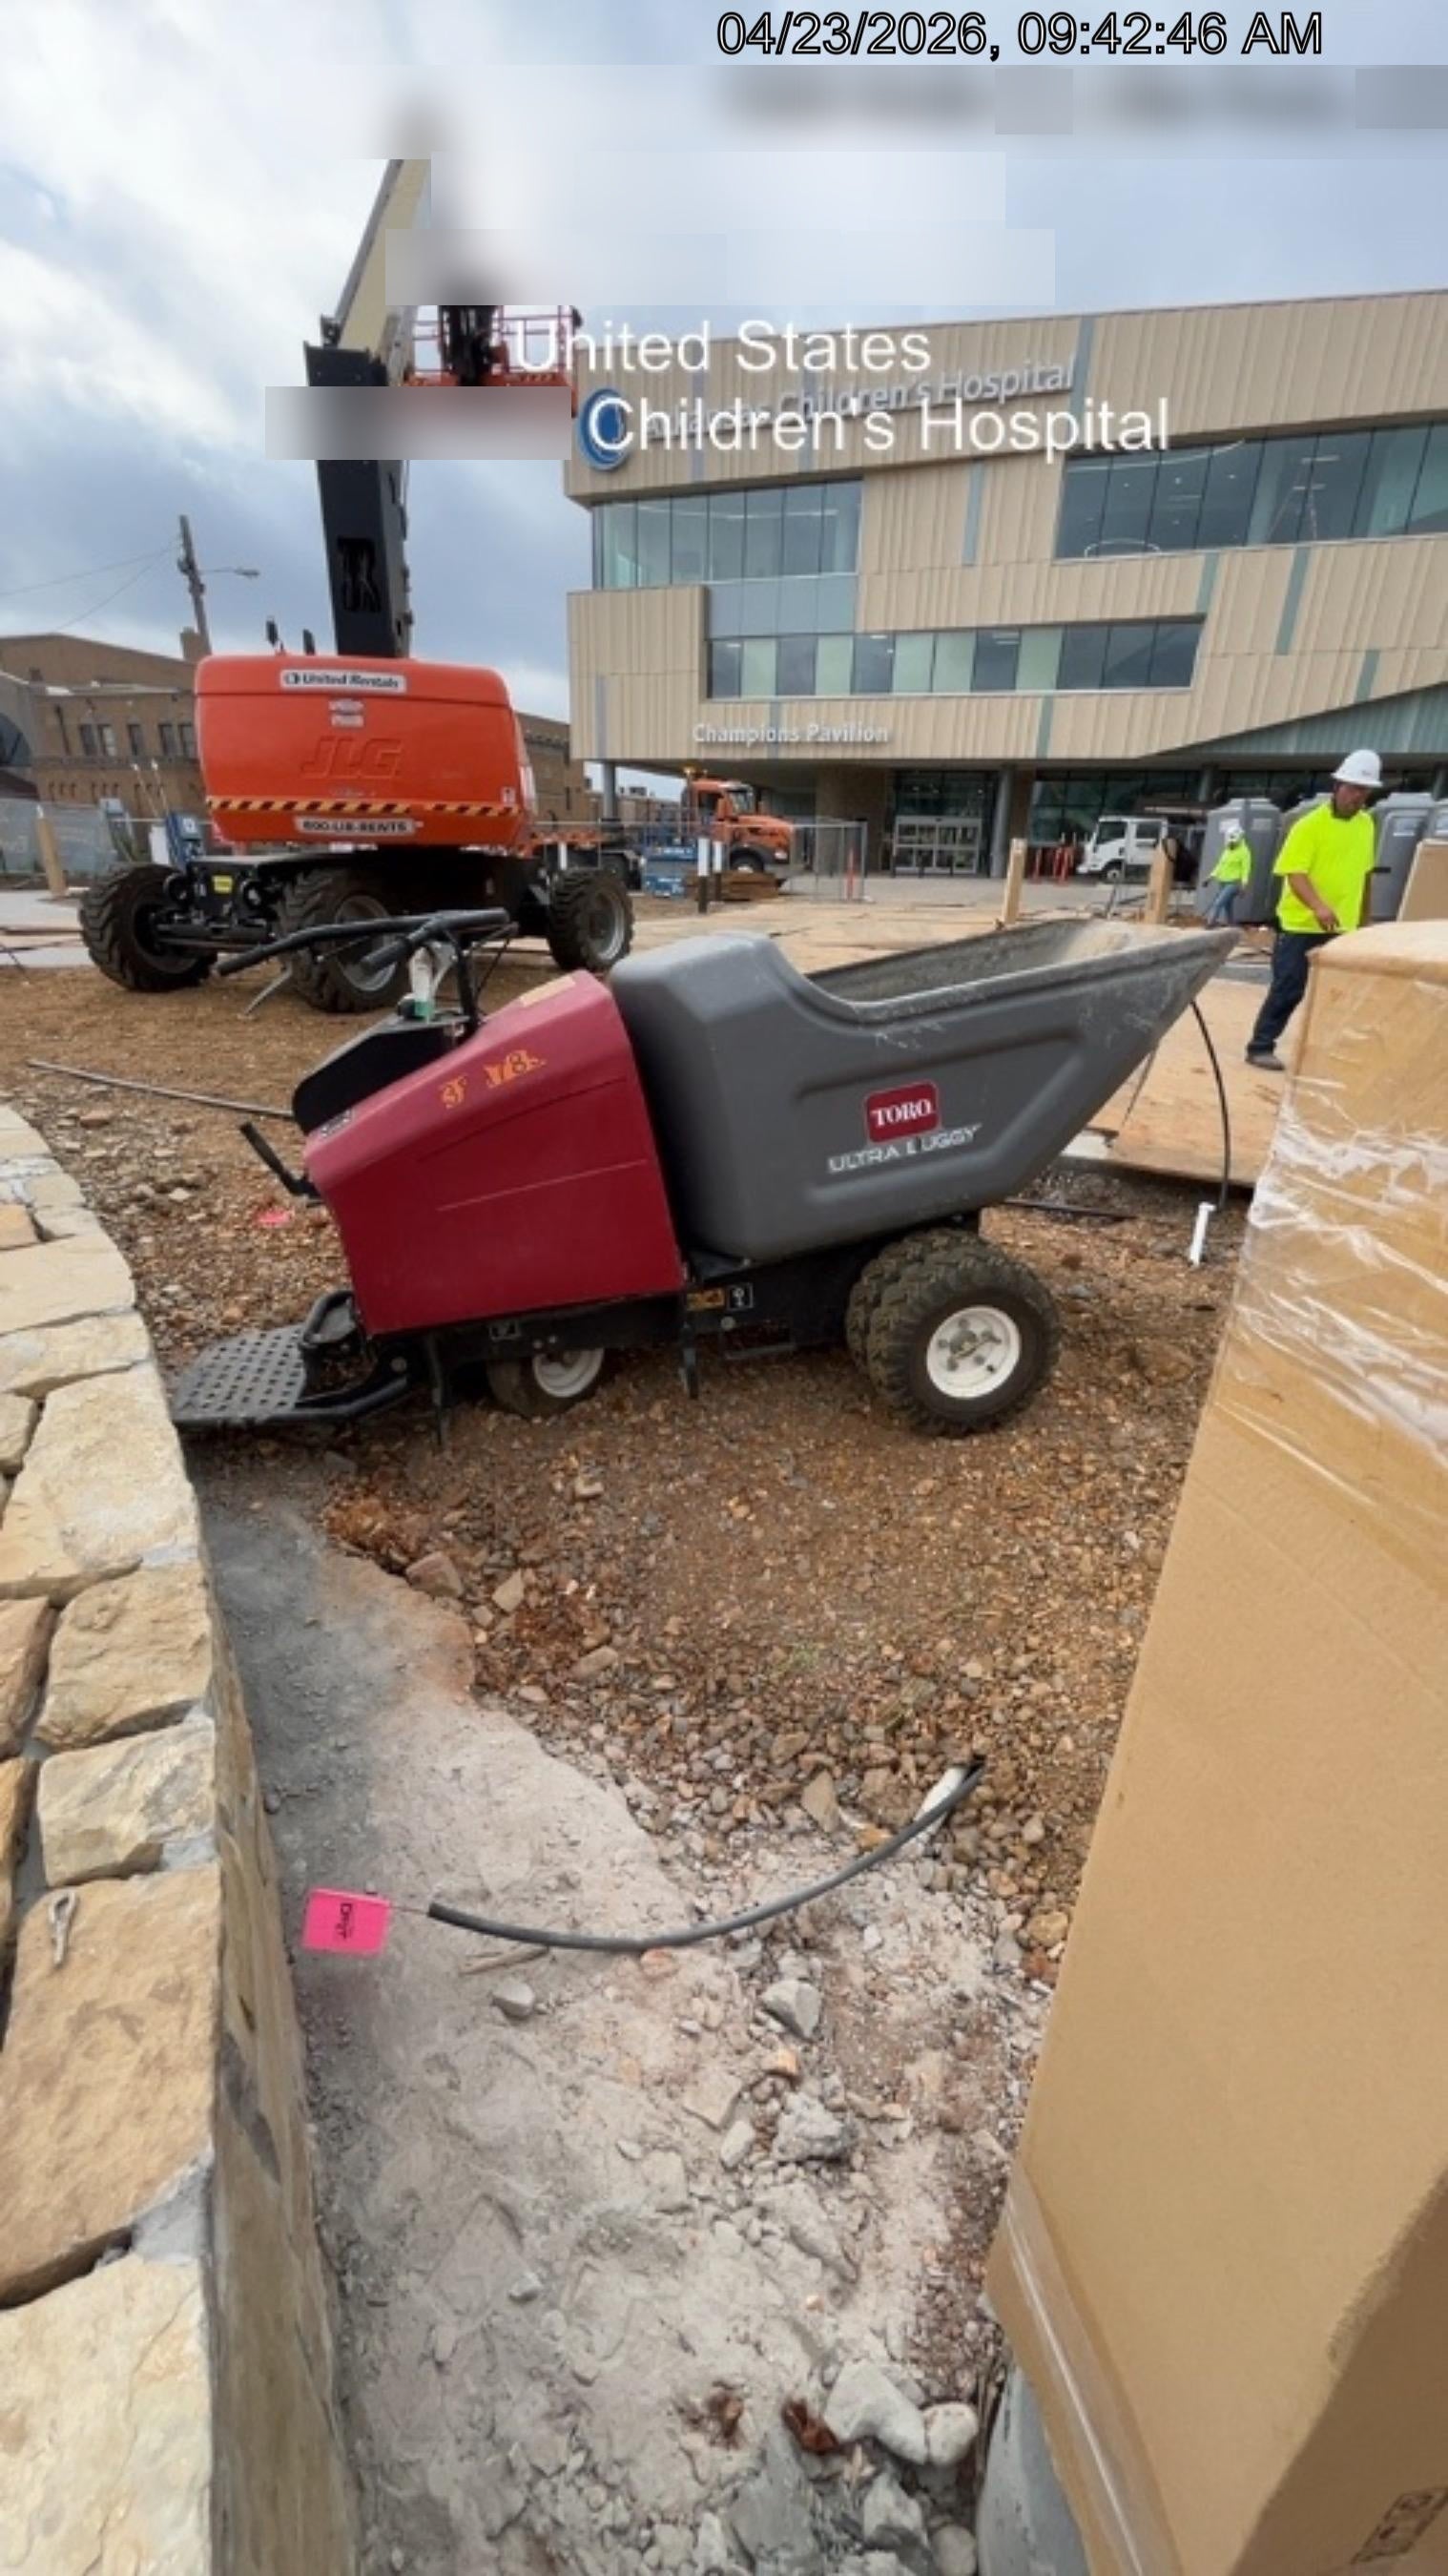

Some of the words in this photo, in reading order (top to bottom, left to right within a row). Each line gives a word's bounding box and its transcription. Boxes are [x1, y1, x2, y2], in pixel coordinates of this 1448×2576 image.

[938, 354, 1076, 405] Hospital
[302, 674, 346, 685] United
[348, 675, 399, 688] Rentals
[693, 722, 800, 748] Champions
[807, 722, 889, 742] Pavilion
[300, 736, 405, 780] JLG
[870, 1098, 935, 1128] TORO
[827, 1144, 900, 1174] ULTRA
